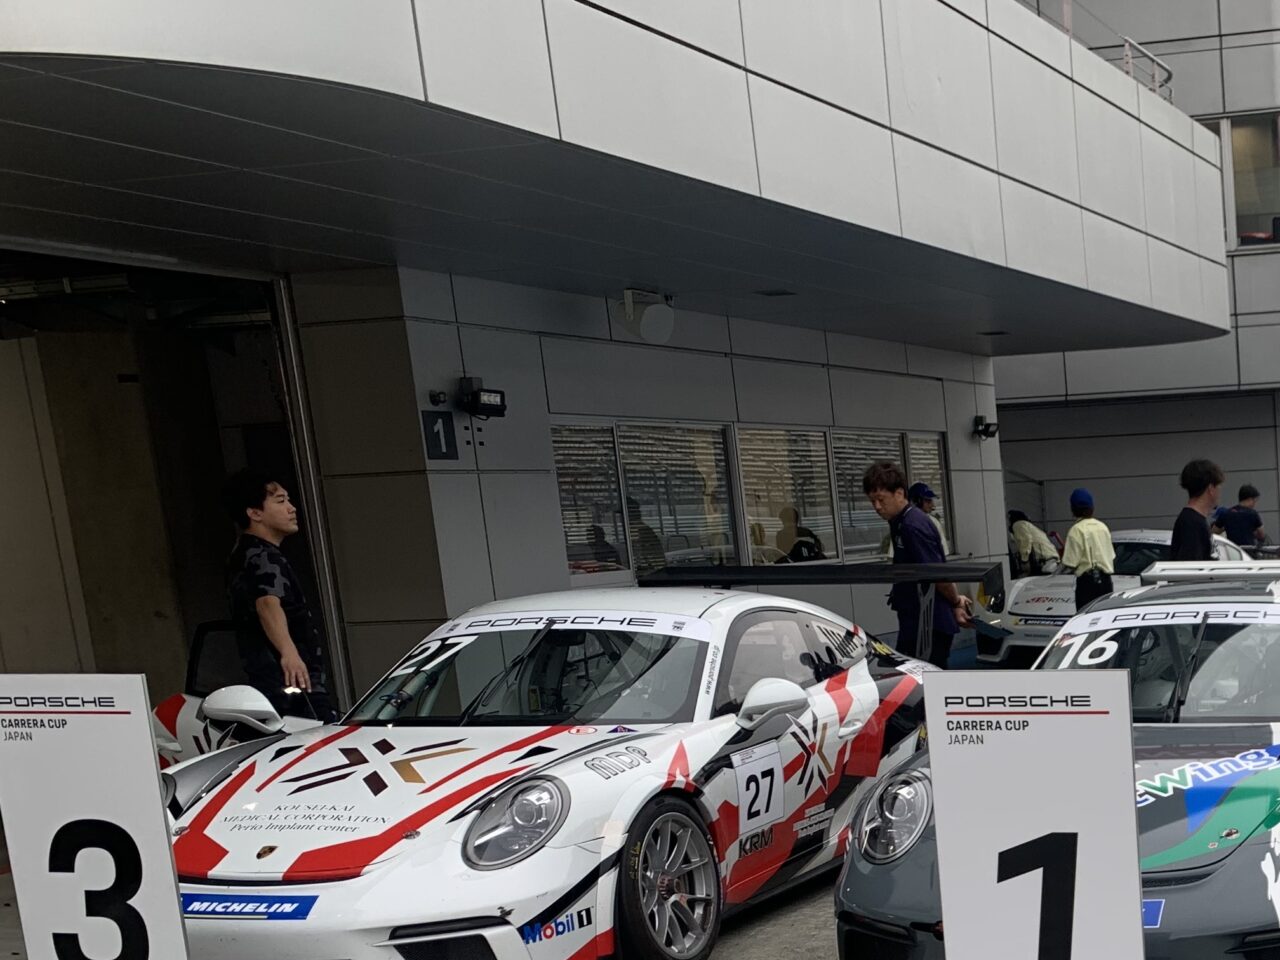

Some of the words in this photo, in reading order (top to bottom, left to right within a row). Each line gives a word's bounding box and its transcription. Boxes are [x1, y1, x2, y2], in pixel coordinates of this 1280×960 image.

[432, 418, 448, 454] 1
[465, 615, 658, 630] PORSCHE
[1058, 629, 1121, 670] 16
[388, 634, 480, 678] 27
[0, 696, 115, 708] PORSCHE
[944, 695, 1091, 707] PORSCHE
[1, 718, 46, 729] CARRERA
[48, 718, 67, 729] CUP
[946, 720, 1002, 731] CARRERA
[1005, 720, 1029, 731] CUP
[4, 731, 33, 741] JAPAN
[948, 734, 984, 745] JAPAN
[745, 767, 775, 821] 27
[222, 814, 280, 823] MEDICAL
[283, 813, 391, 824] CORPORATION
[265, 823, 315, 831] Implant
[317, 825, 360, 833] center
[739, 827, 774, 859] KRM
[187, 902, 299, 912] MICHELIN
[523, 912, 574, 945] Mobil
